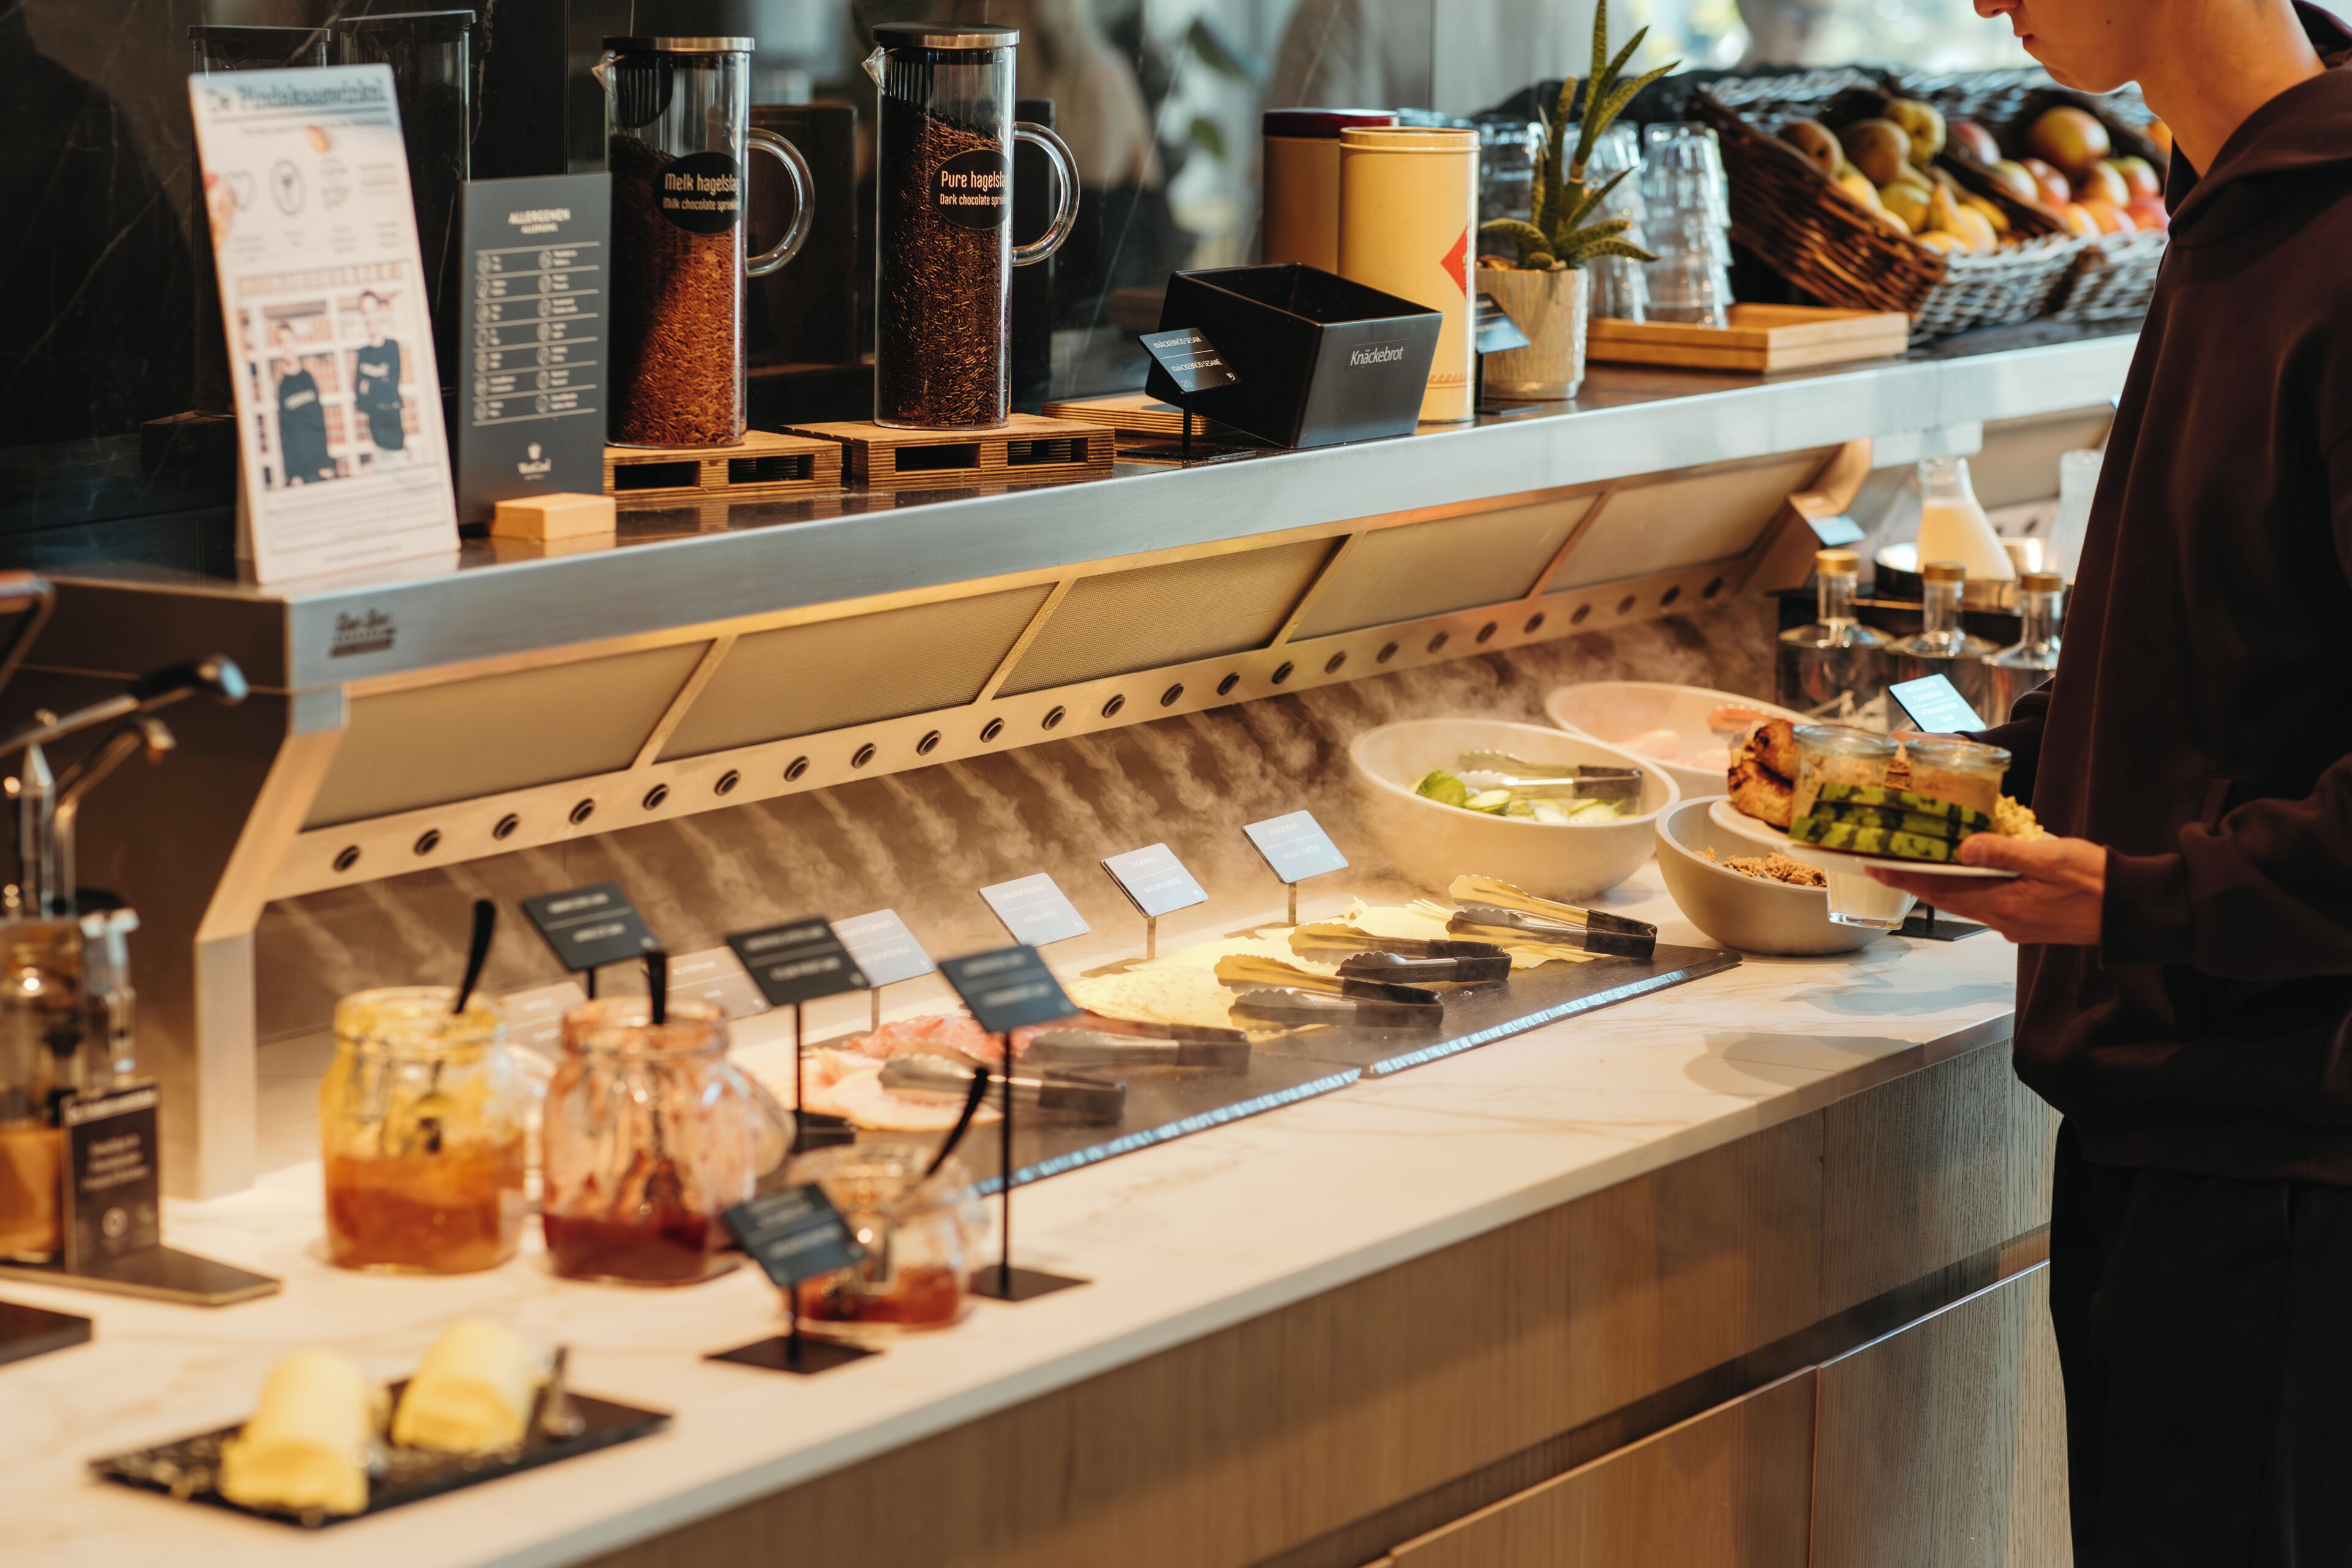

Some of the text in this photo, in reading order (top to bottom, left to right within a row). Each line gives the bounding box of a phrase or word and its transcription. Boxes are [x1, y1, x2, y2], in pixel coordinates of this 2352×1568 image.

[665, 173, 694, 191] Melk
[941, 170, 967, 187] Pure
[663, 197, 680, 209] Milk
[681, 198, 716, 210] chocolate
[940, 193, 957, 205] Dark
[959, 194, 990, 206] chocolate
[1350, 345, 1404, 366] Knäckebrot
